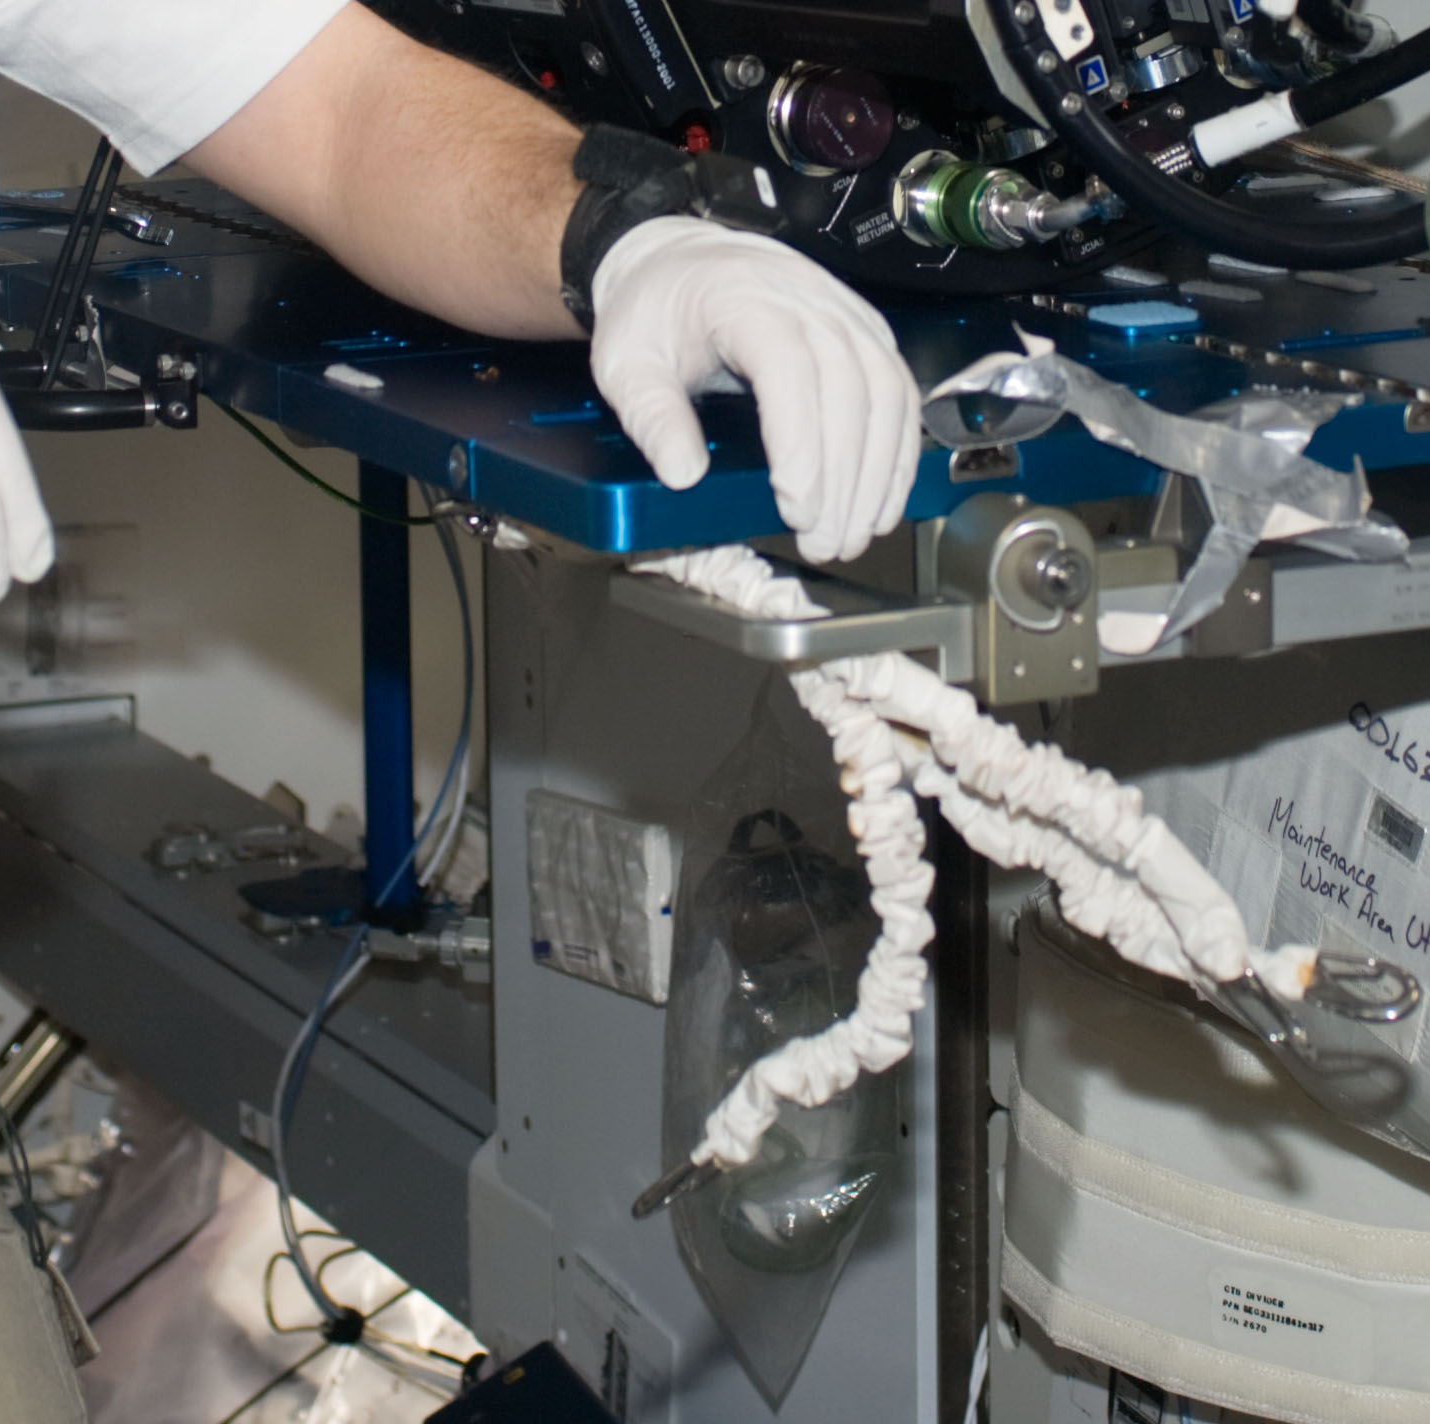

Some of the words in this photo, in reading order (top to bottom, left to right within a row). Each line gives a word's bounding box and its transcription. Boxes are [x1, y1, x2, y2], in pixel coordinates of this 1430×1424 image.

[831, 174, 856, 194] JCIA
[855, 212, 889, 234] WATER
[856, 222, 895, 246] RETURN
[1268, 797, 1379, 895] Maintenance
[1300, 861, 1349, 910] Work
[1357, 893, 1395, 944] Area
[1222, 1299, 1239, 1311] P/N
[1223, 1284, 1241, 1296] CTB
[1246, 1291, 1285, 1308] DIVIDER
[1222, 1313, 1239, 1325] S/N
[1243, 1320, 1267, 1333] 2670
